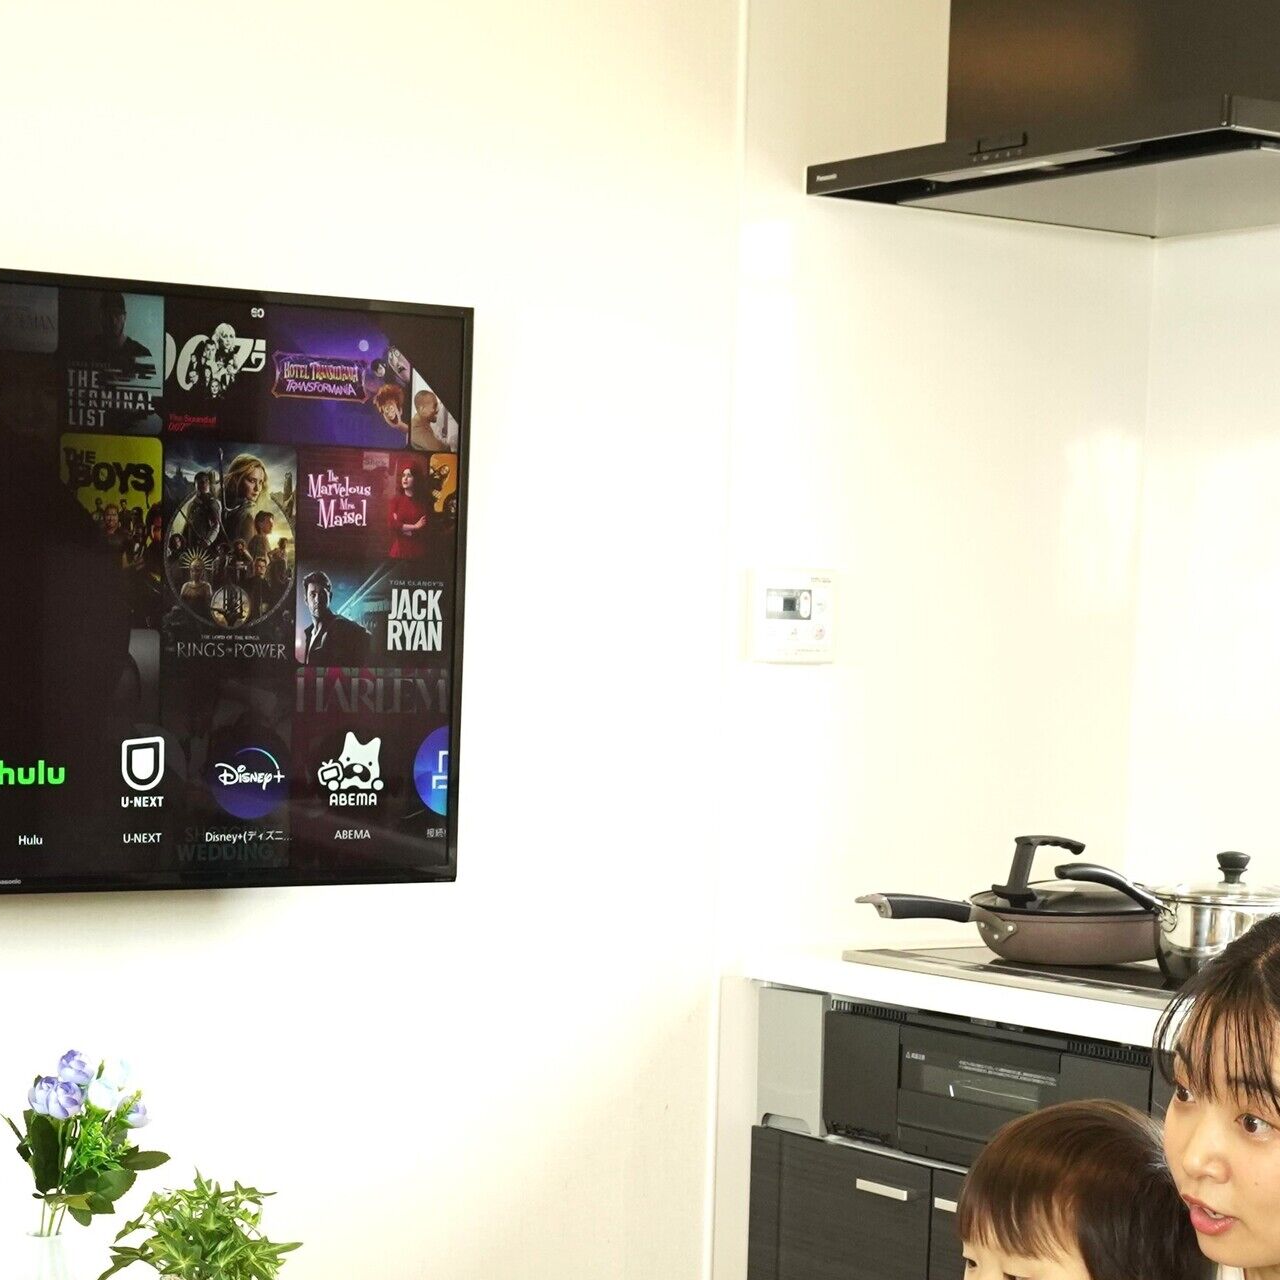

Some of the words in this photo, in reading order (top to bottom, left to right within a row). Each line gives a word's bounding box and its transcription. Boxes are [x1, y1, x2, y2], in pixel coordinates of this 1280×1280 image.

[67, 369, 100, 389] THE
[284, 361, 309, 380] HOTEL
[286, 379, 357, 396] TRANSFORMANIA
[67, 388, 156, 411] TERMINAL
[68, 409, 106, 428] LIST
[71, 461, 155, 494] BOYS
[327, 469, 339, 483] The
[307, 474, 372, 500] Marvelous
[317, 499, 368, 529] Maisel
[388, 588, 443, 620] JACK
[387, 620, 442, 652] RYAN
[177, 641, 226, 658] RINGS
[234, 643, 288, 661] POWER
[329, 792, 379, 806] ABEMA
[18, 834, 44, 846] Hulu
[122, 833, 162, 844] U-NEXT
[334, 829, 372, 841] ABEMA
[426, 828, 447, 839] 接続
